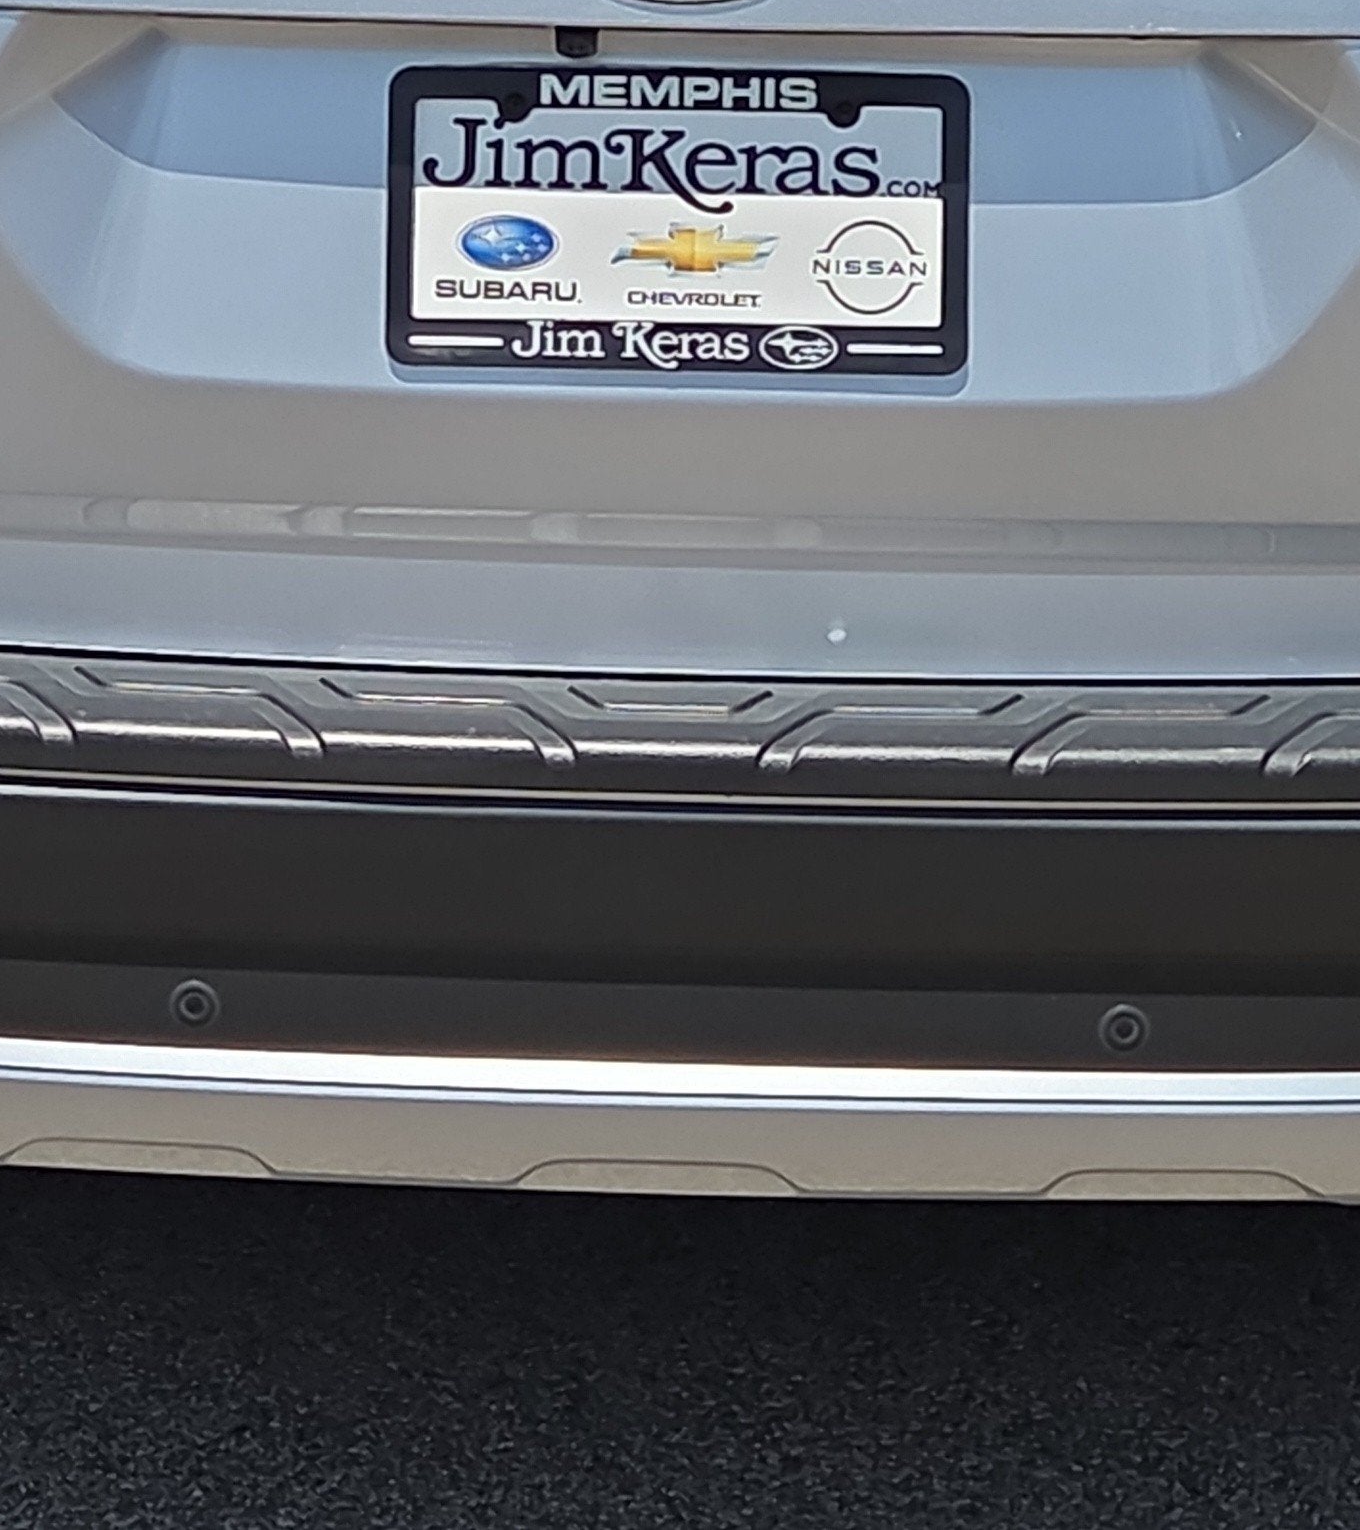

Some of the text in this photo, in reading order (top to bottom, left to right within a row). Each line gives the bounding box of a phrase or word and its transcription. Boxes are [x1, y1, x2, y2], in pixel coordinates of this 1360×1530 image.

[539, 74, 818, 110] MEMPHIS
[812, 257, 927, 278] NISSAN
[435, 280, 576, 302] SUBARU
[627, 291, 759, 308] CHEVROLET
[511, 322, 750, 368] Jim Keras
